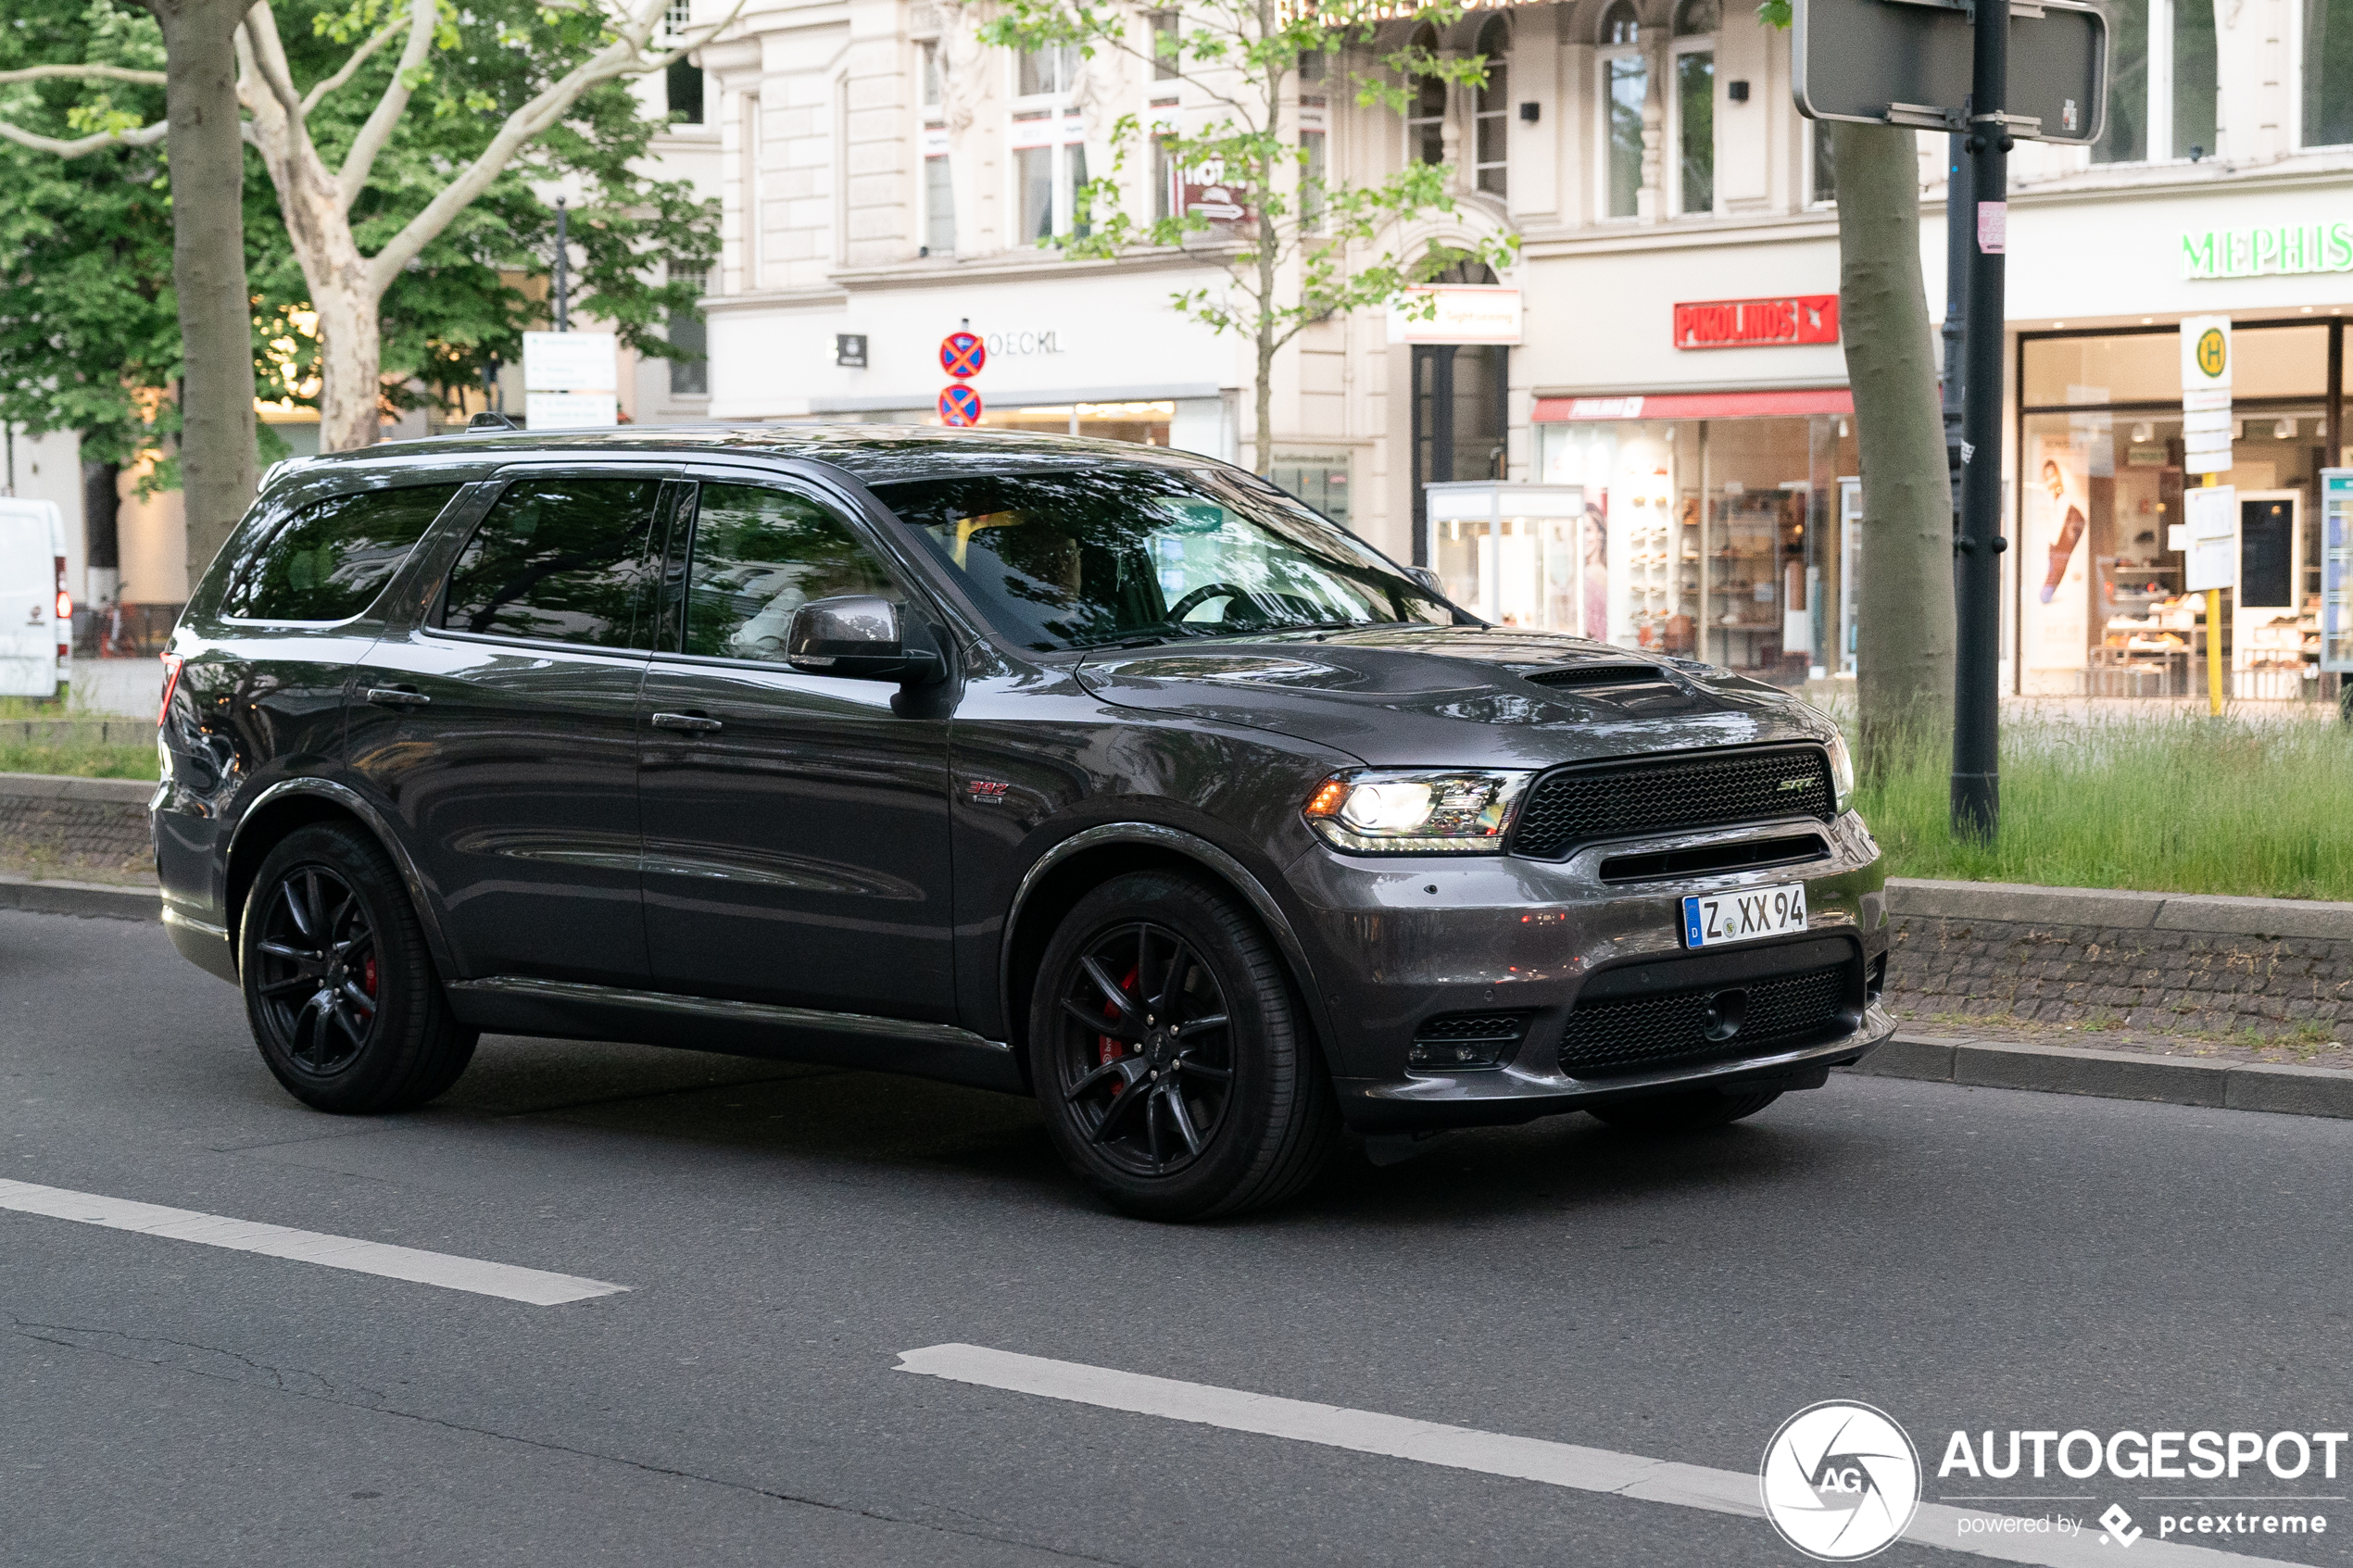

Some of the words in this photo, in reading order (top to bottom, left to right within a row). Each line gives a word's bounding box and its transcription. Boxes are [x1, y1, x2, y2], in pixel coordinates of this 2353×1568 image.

[1185, 158, 1246, 189] HOT
[2182, 222, 2353, 275] MEPHIS
[1677, 301, 1795, 344] PIKOLINOS
[987, 331, 1064, 357] OECKL
[2207, 340, 2221, 366] H
[966, 780, 1009, 796] 392
[1777, 776, 1816, 793] SRT
[1704, 901, 1722, 939] Z
[1737, 894, 1771, 935] XX
[1774, 889, 1804, 928] 94
[1692, 927, 1698, 938] D
